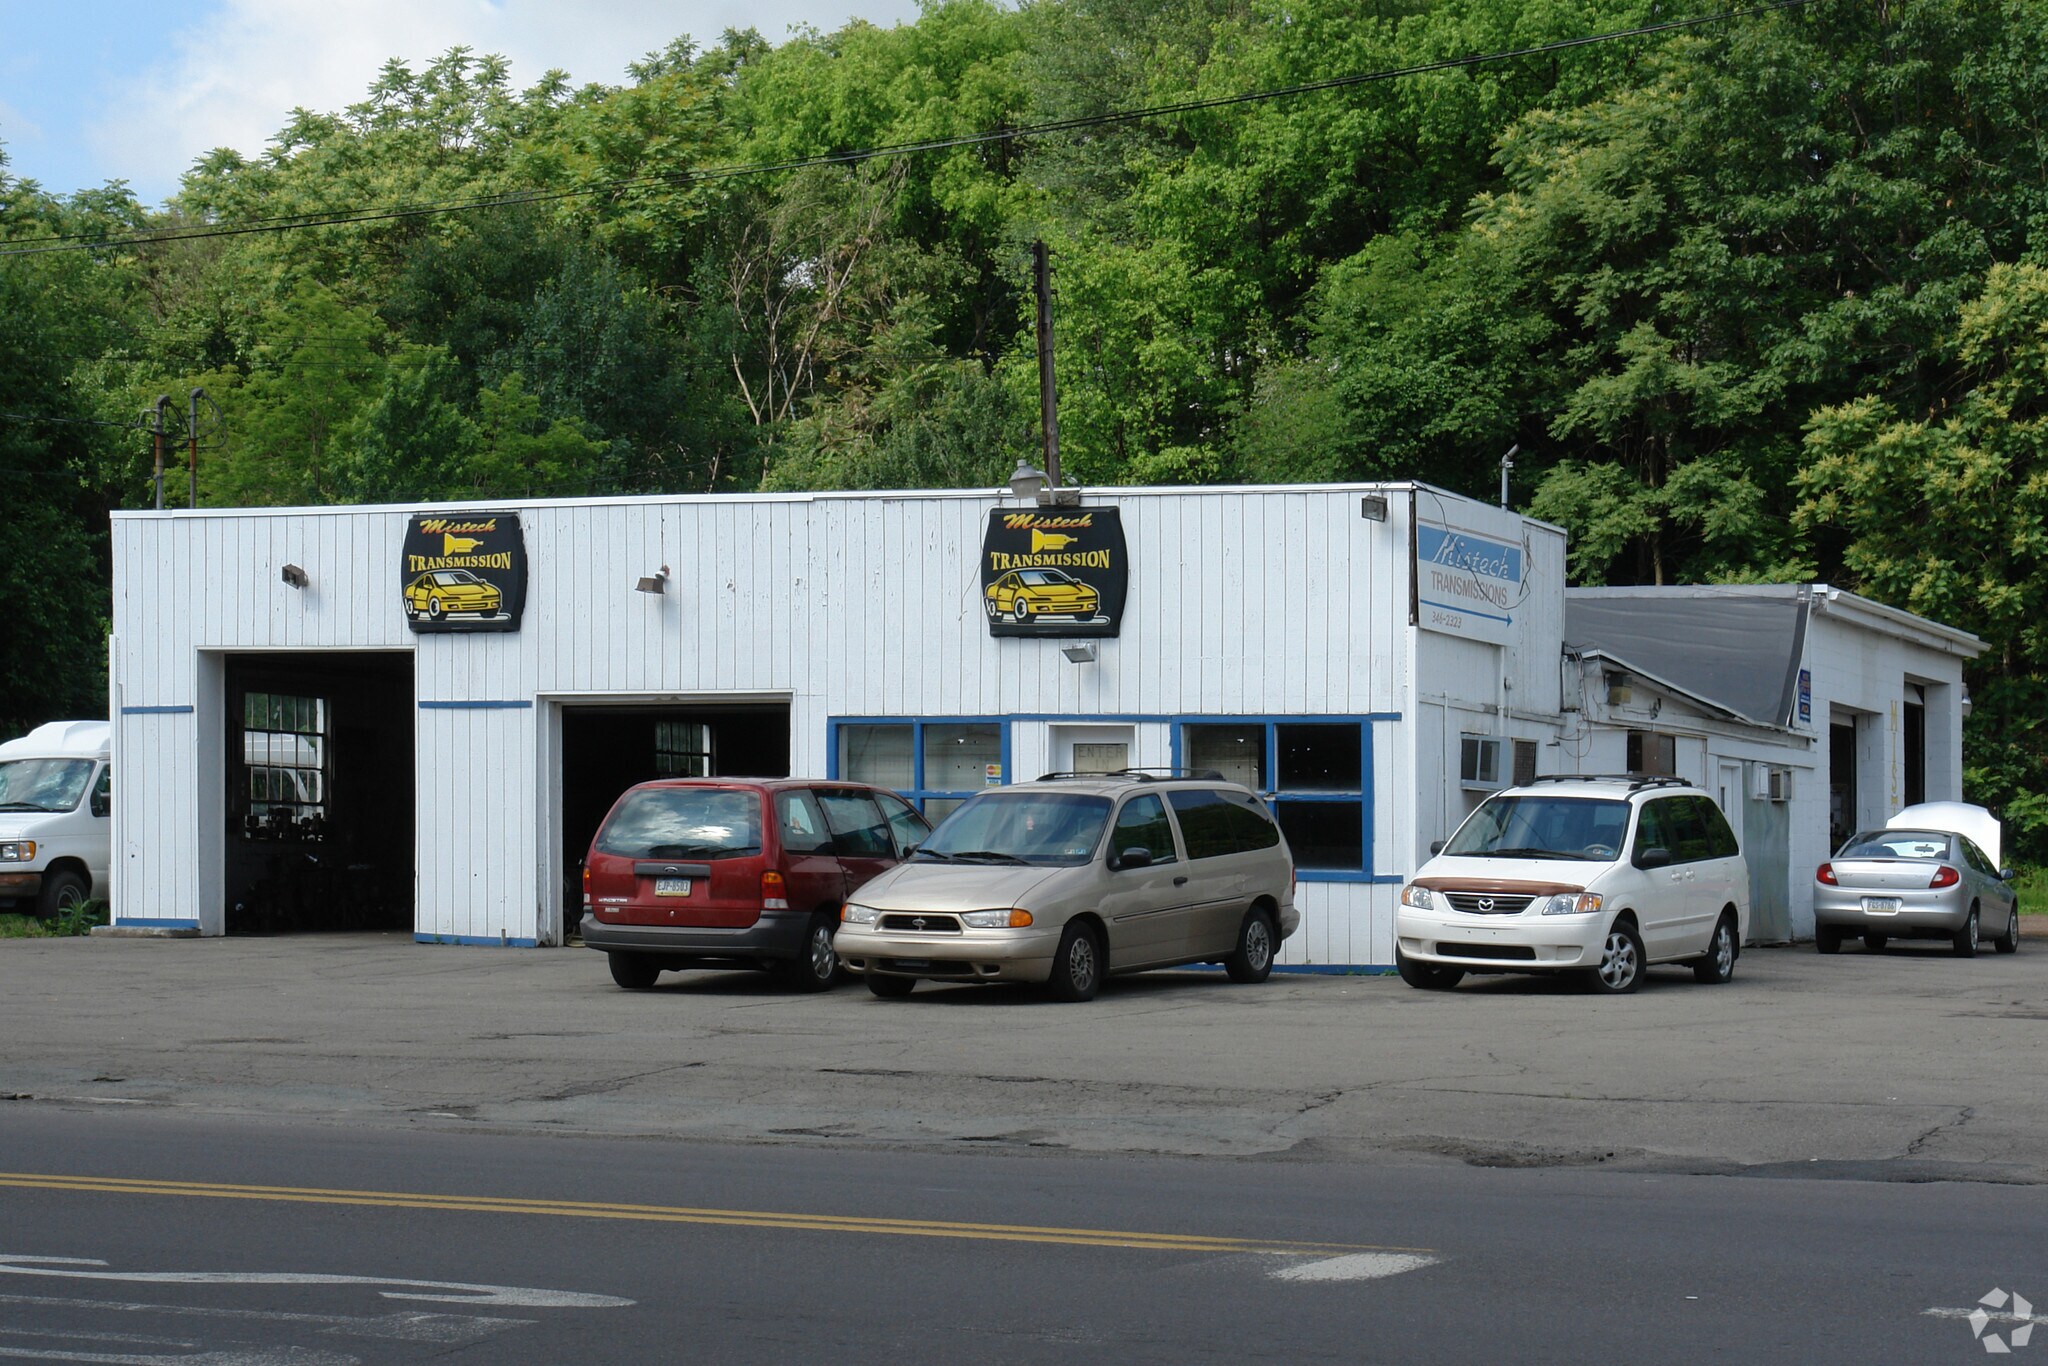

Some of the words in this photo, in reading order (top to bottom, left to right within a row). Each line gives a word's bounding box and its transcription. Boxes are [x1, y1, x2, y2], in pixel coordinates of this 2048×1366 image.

[419, 518, 497, 535] Mistech
[1003, 512, 1093, 530] Mistech
[408, 551, 512, 573] TRANSMISSION
[990, 549, 1111, 571] TRANSMISSION
[1432, 533, 1509, 580] Mistech
[1431, 570, 1508, 606] TRANSMISSIONS
[657, 880, 688, 892] EJP-8503
